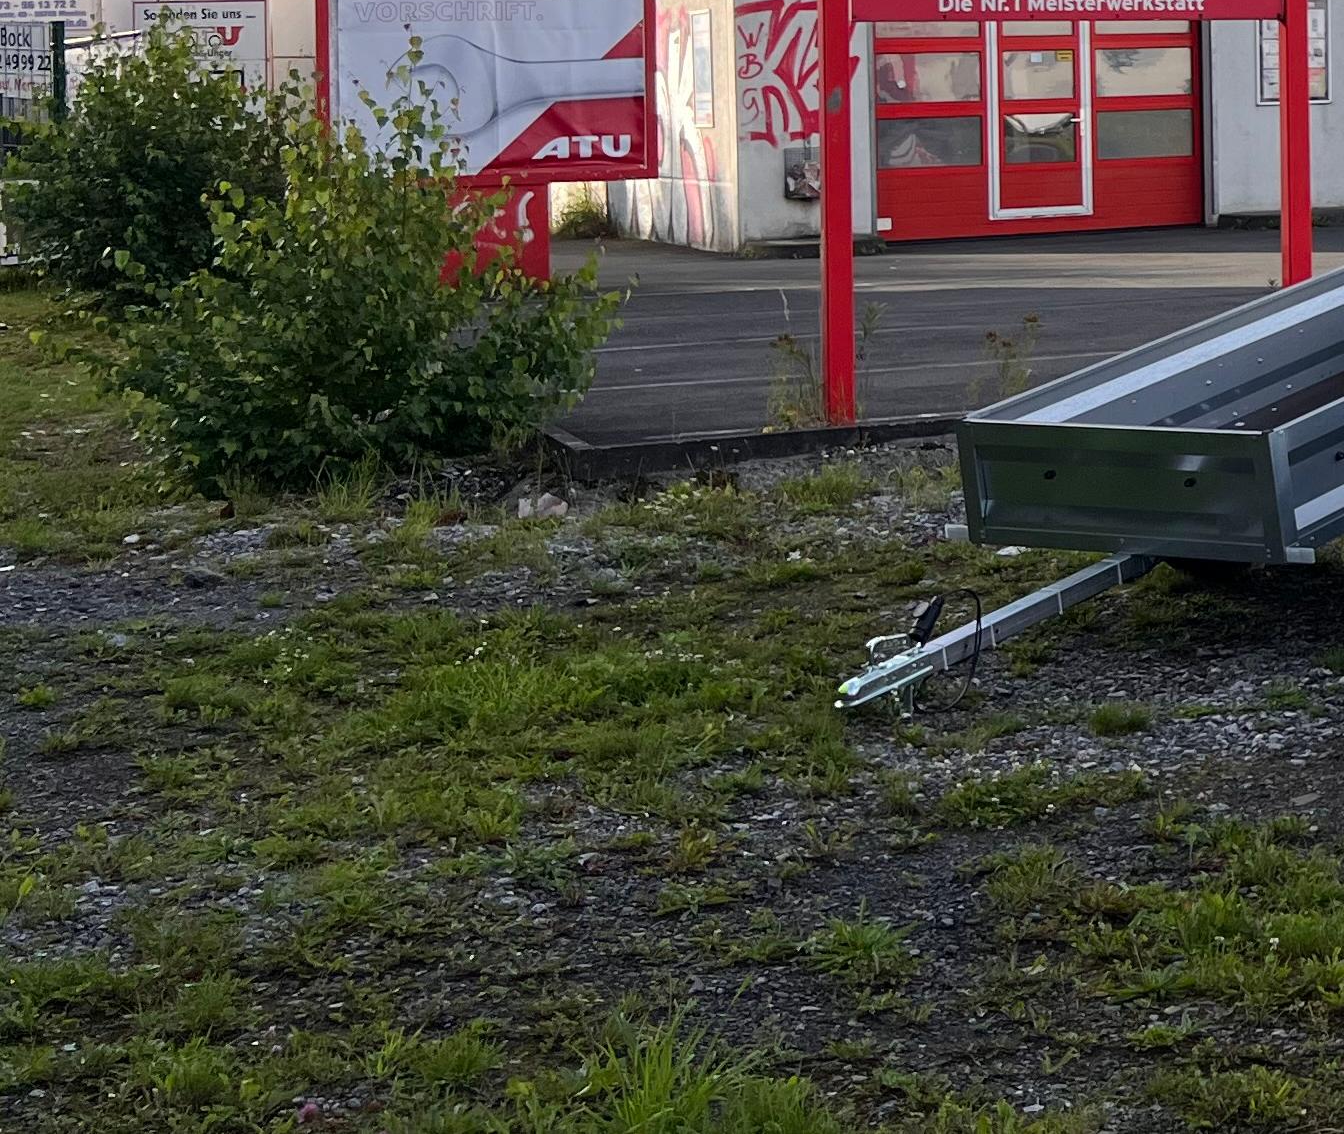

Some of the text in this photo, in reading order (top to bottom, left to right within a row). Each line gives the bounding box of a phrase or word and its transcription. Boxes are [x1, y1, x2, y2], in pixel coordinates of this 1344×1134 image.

[143, 8, 157, 21] So
[201, 8, 218, 21] Sie
[222, 10, 242, 20] uns
[354, 0, 545, 23] VORSCHRIFT.
[1, 27, 31, 47] Bock
[531, 134, 632, 160] ATU
